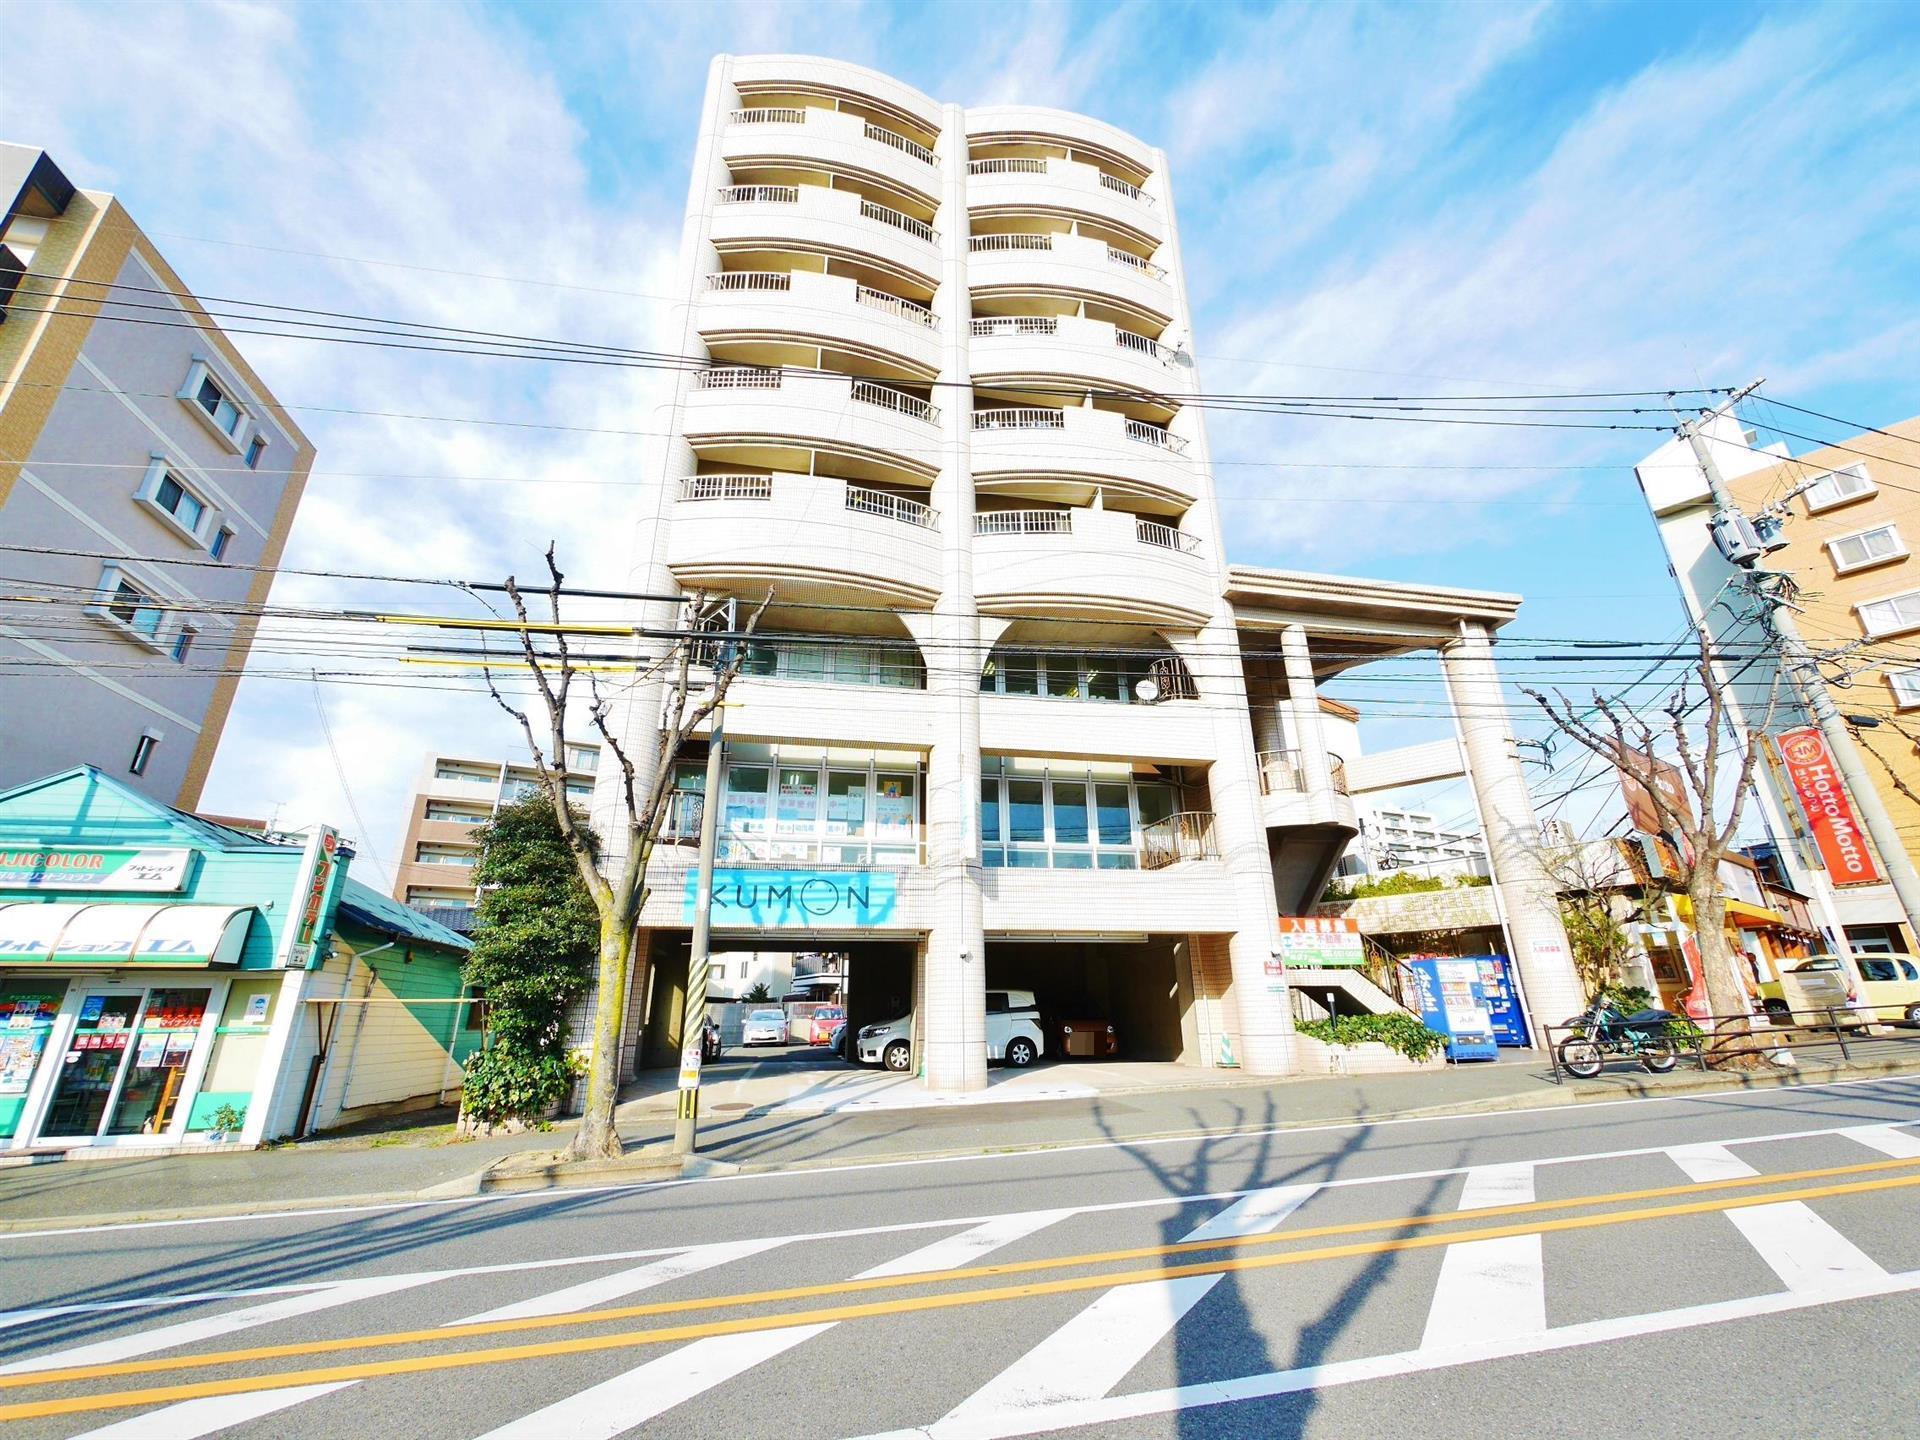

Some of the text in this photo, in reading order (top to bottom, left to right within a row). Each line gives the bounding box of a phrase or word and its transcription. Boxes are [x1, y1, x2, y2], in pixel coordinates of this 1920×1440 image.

[1794, 768, 1822, 813] ほっともっと
[302, 860, 332, 944] フジカラー
[1417, 967, 1440, 1012] Asahi
